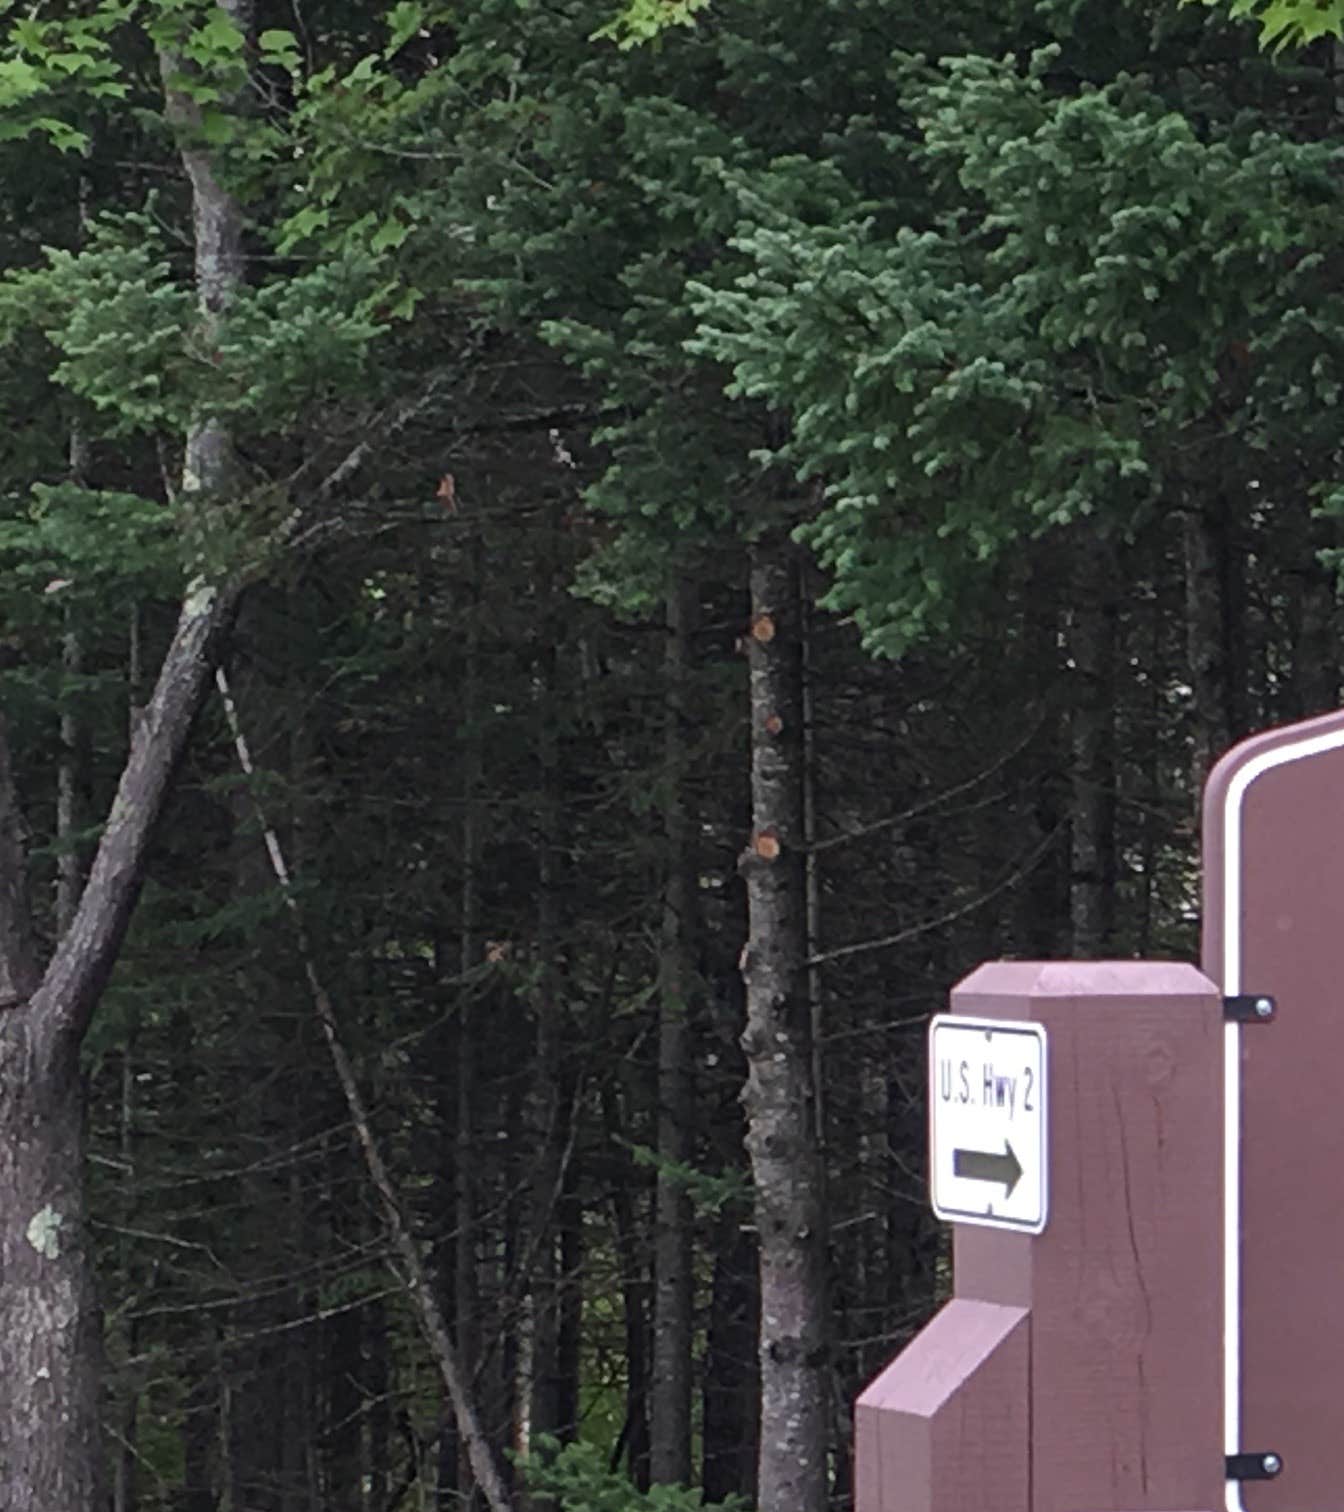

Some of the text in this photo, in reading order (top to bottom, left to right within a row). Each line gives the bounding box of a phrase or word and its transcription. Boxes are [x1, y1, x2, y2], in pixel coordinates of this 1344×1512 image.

[941, 1058, 1034, 1120] U.S. Hwy 2
